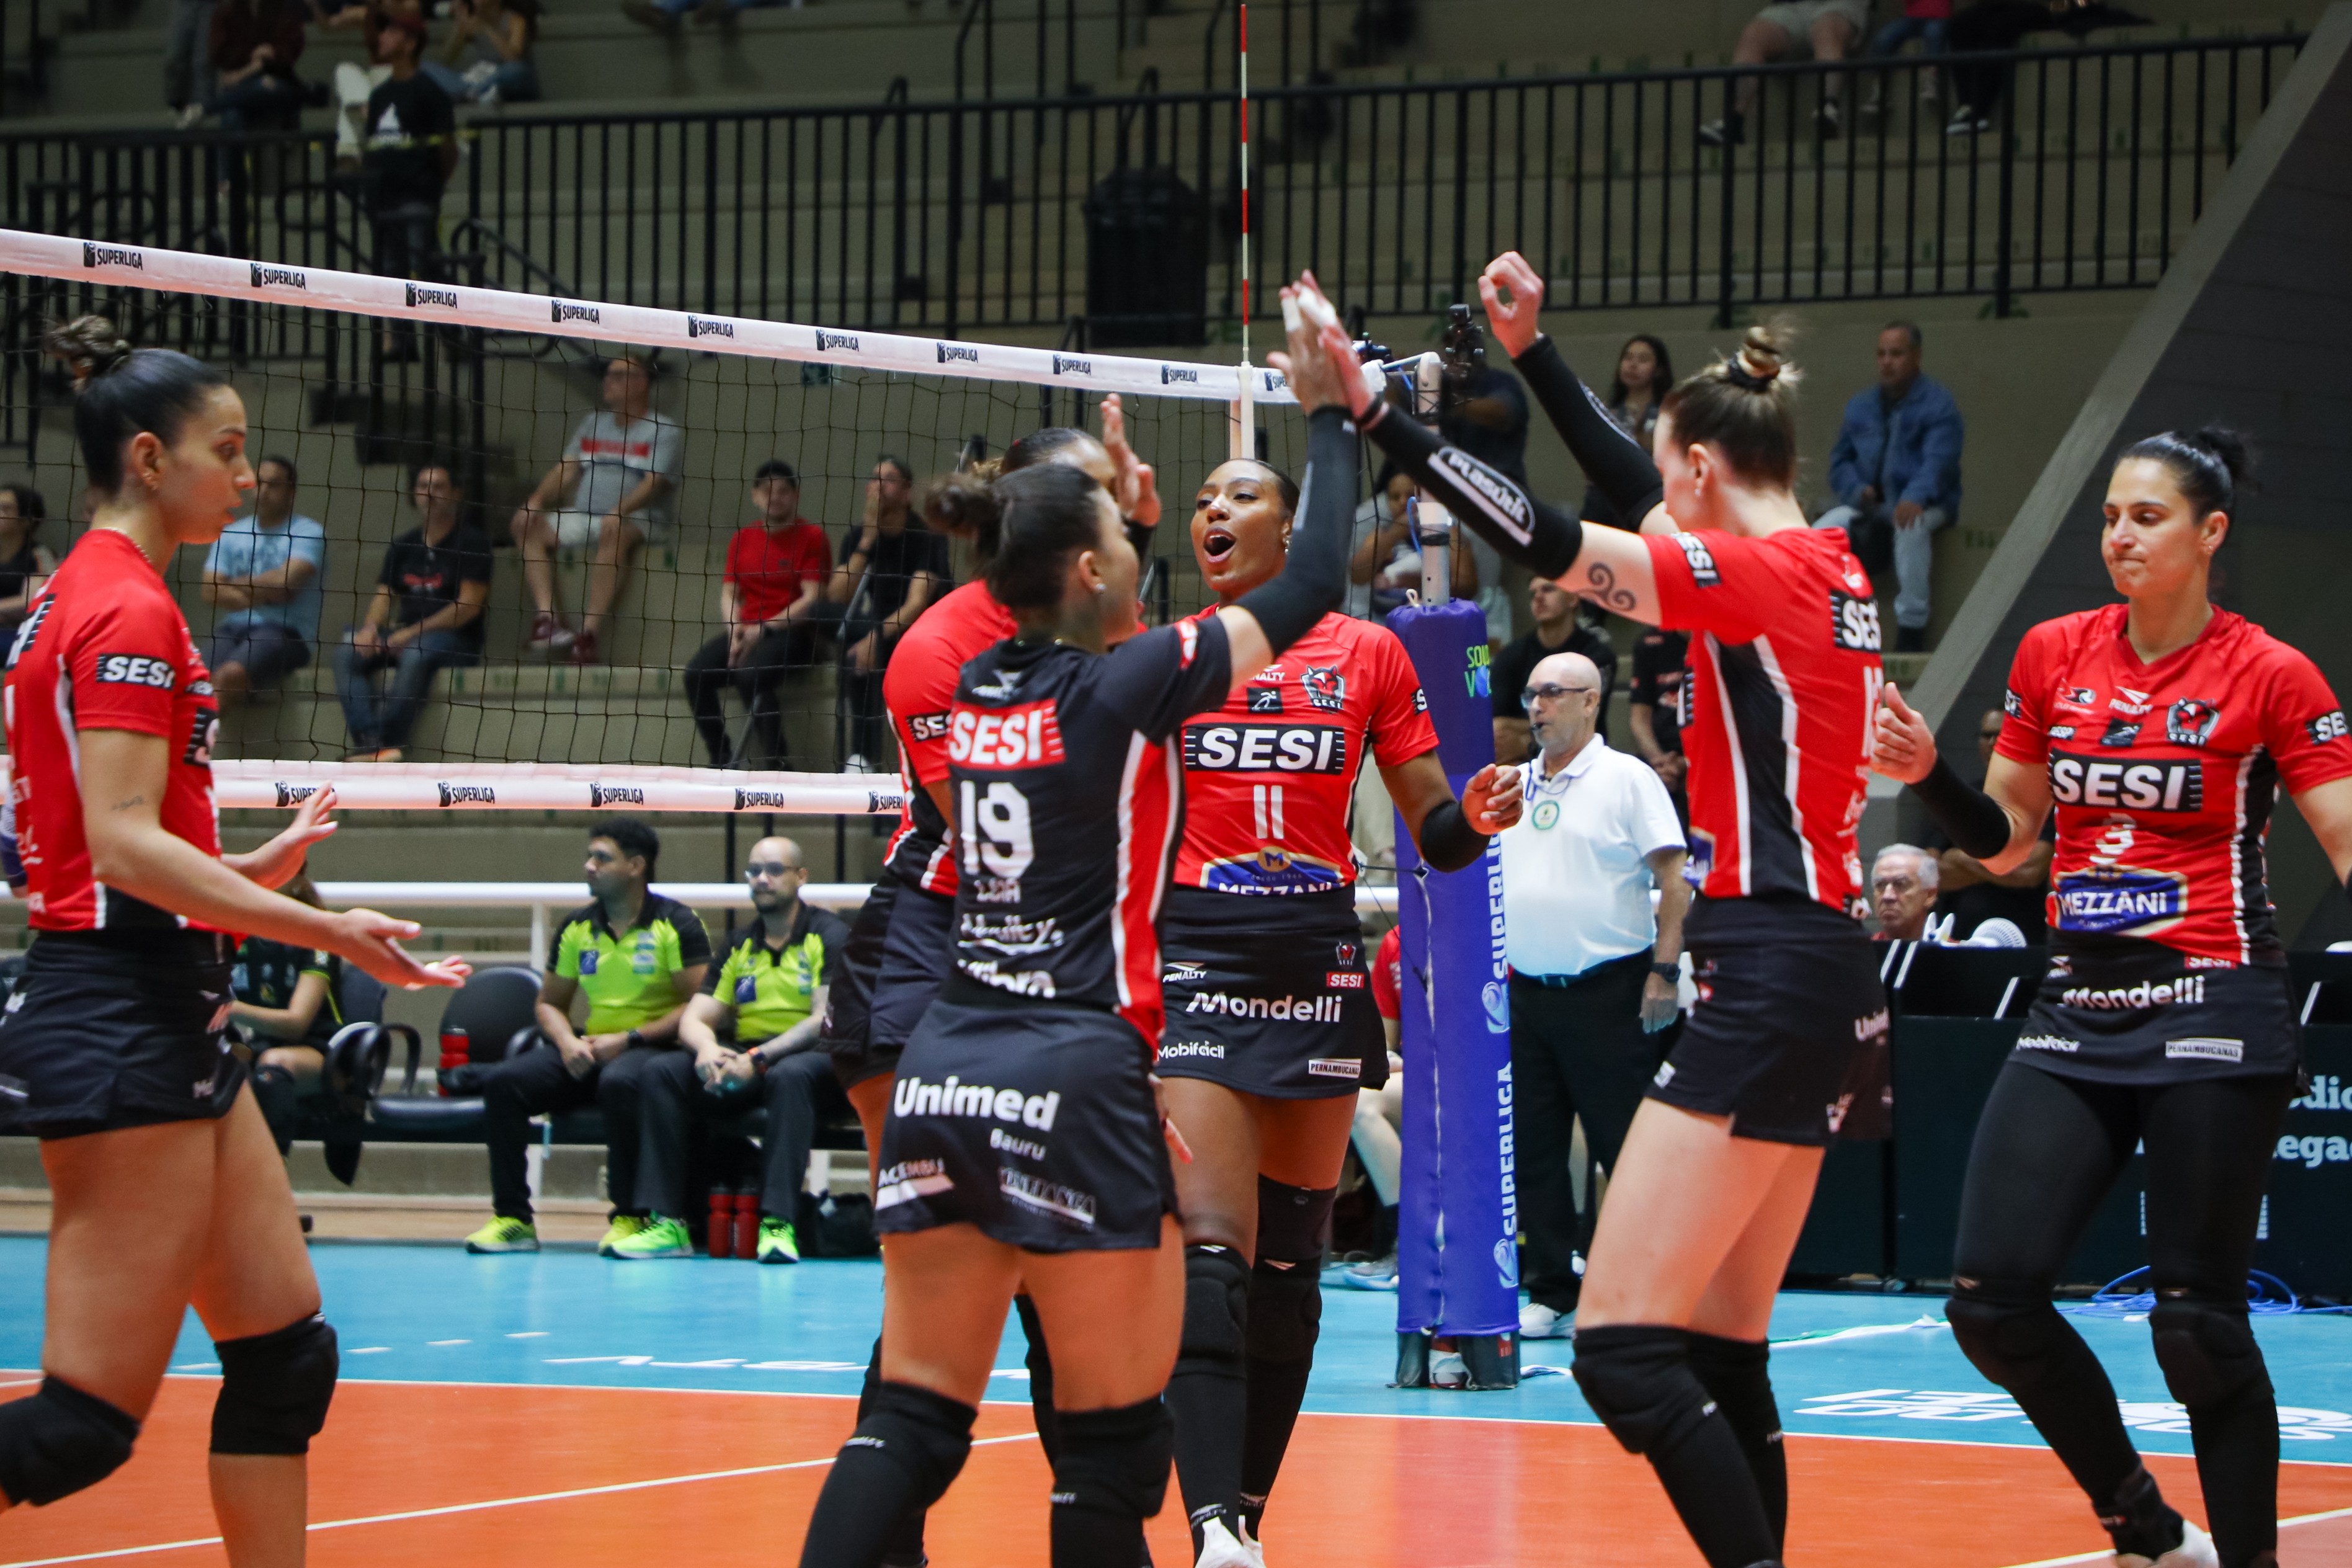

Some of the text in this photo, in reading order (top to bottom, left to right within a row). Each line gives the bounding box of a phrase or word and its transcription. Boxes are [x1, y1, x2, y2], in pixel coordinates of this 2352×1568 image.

[97, 247, 143, 270] SUPERLIGA
[263, 268, 306, 290] SUPERLIGA
[417, 288, 458, 309] SUPERLIGA
[562, 303, 600, 325] SUPERLIGA
[698, 319, 734, 339] SUPERLIGA
[826, 332, 860, 352] SUPERLIGA
[946, 345, 979, 363] SUPERLIGA
[1061, 358, 1092, 376] SUPERLIGA
[1169, 367, 1198, 385] SUPERLIGA
[103, 655, 176, 688] SESI
[948, 710, 1043, 765] SESI
[1198, 727, 1334, 770] SESI
[2053, 758, 2186, 809] SESI
[452, 786, 496, 805] SUPERLIGA
[602, 787, 644, 806] SUPERLIGA
[745, 791, 785, 809] SUPERLIGA
[1253, 784, 1285, 840] 11
[960, 780, 1035, 878] 19
[2058, 891, 2168, 917] MEZZANI
[1162, 970, 1207, 983] PENALTY
[1330, 973, 1362, 987] SESI
[1185, 992, 1343, 1023] Mondelli
[1311, 1063, 1360, 1075] PERNAMBUCANA
[894, 1076, 1061, 1133] Unimed
[990, 1128, 1046, 1161] Bauru
[1498, 1061, 1517, 1237] SUPERLIGA
